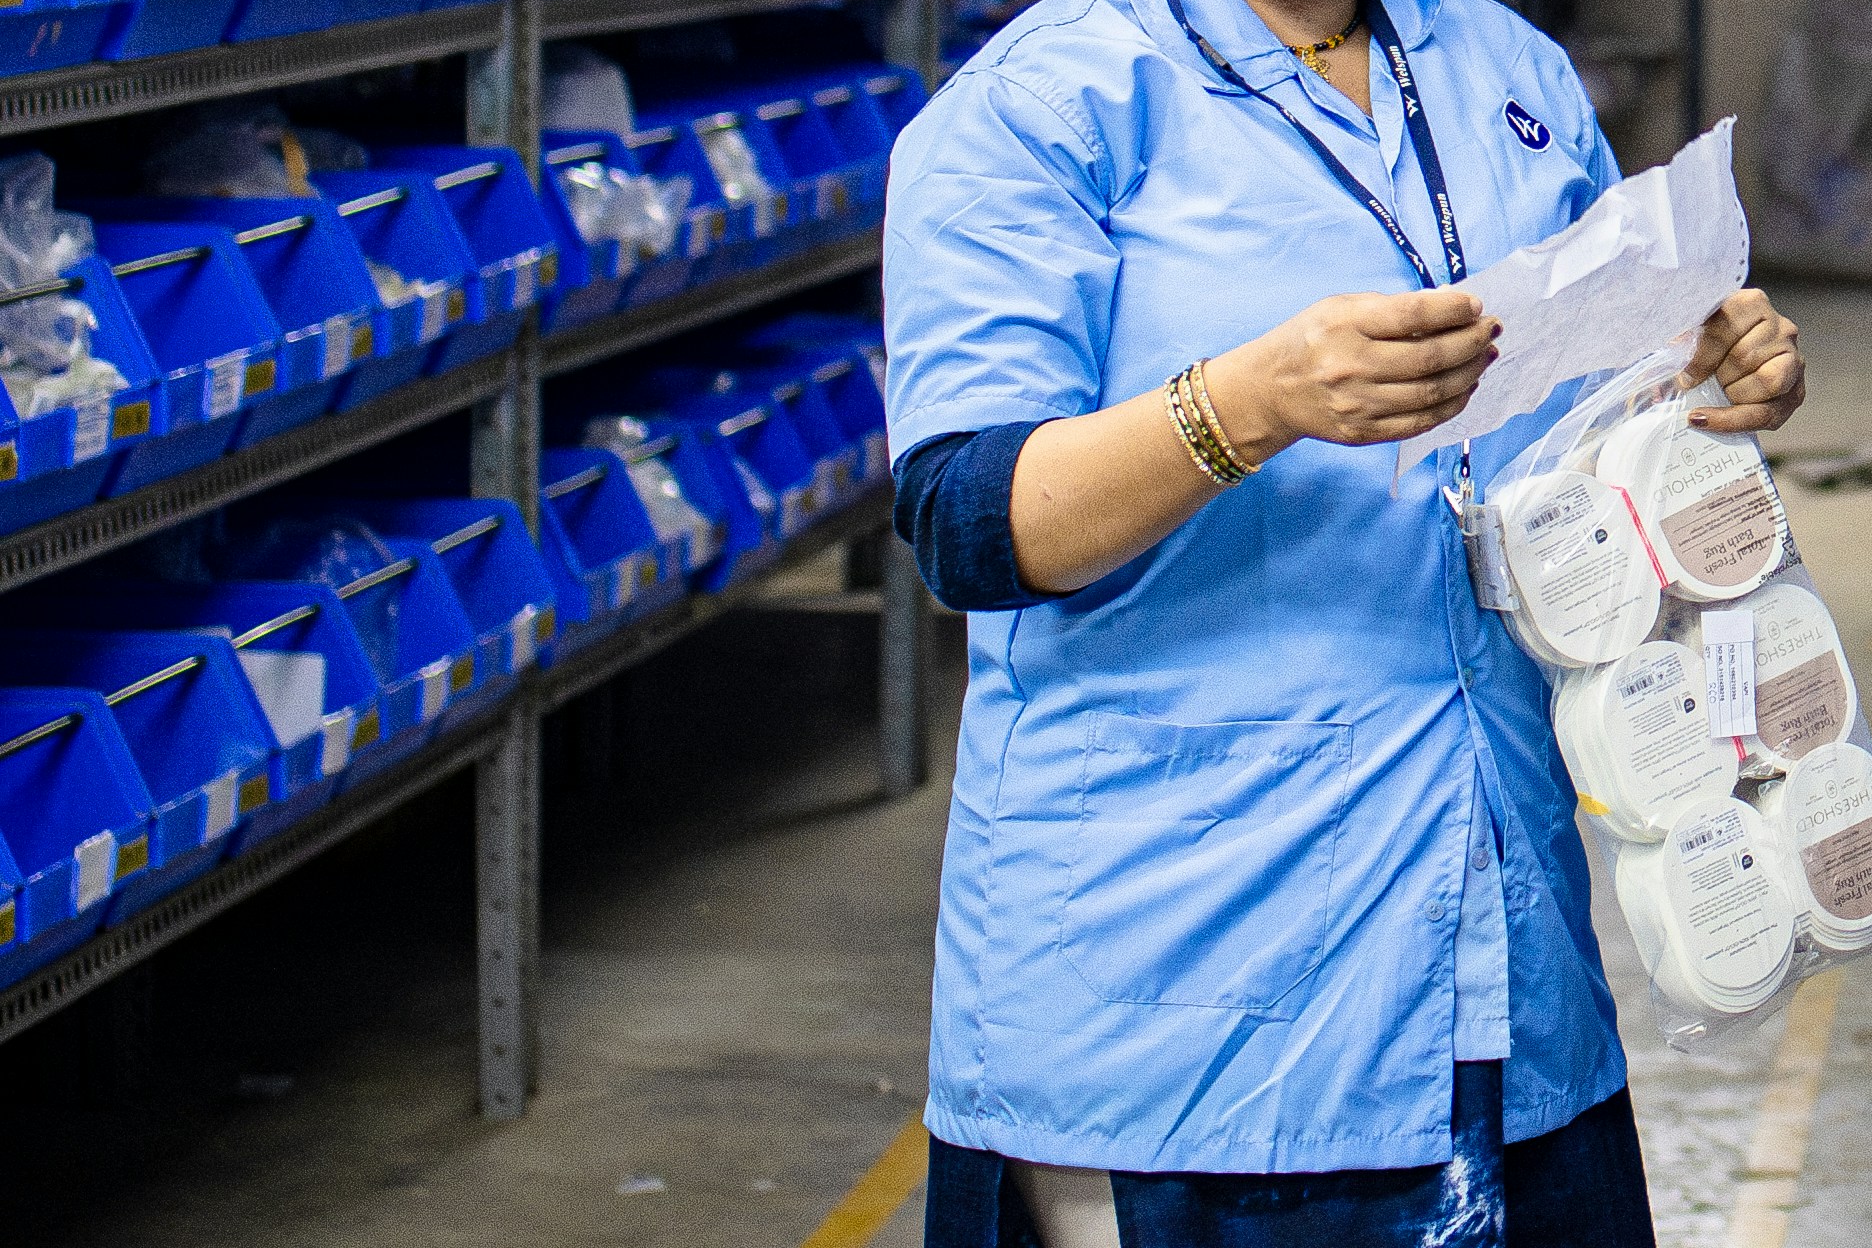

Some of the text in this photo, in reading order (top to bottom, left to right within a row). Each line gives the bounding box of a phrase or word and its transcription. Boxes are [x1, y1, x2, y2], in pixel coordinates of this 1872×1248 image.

[1389, 45, 1412, 88] Welspun
[1437, 193, 1456, 244] Welspun
[1653, 450, 1744, 504] THRESHOLD
[1703, 543, 1728, 559] Rug
[1726, 528, 1755, 549] Bath
[1703, 539, 1767, 575] Total Fresh
[1755, 625, 1824, 667] THRESHO
[1833, 886, 1864, 908] Fresh
[1834, 875, 1856, 892] Rug
